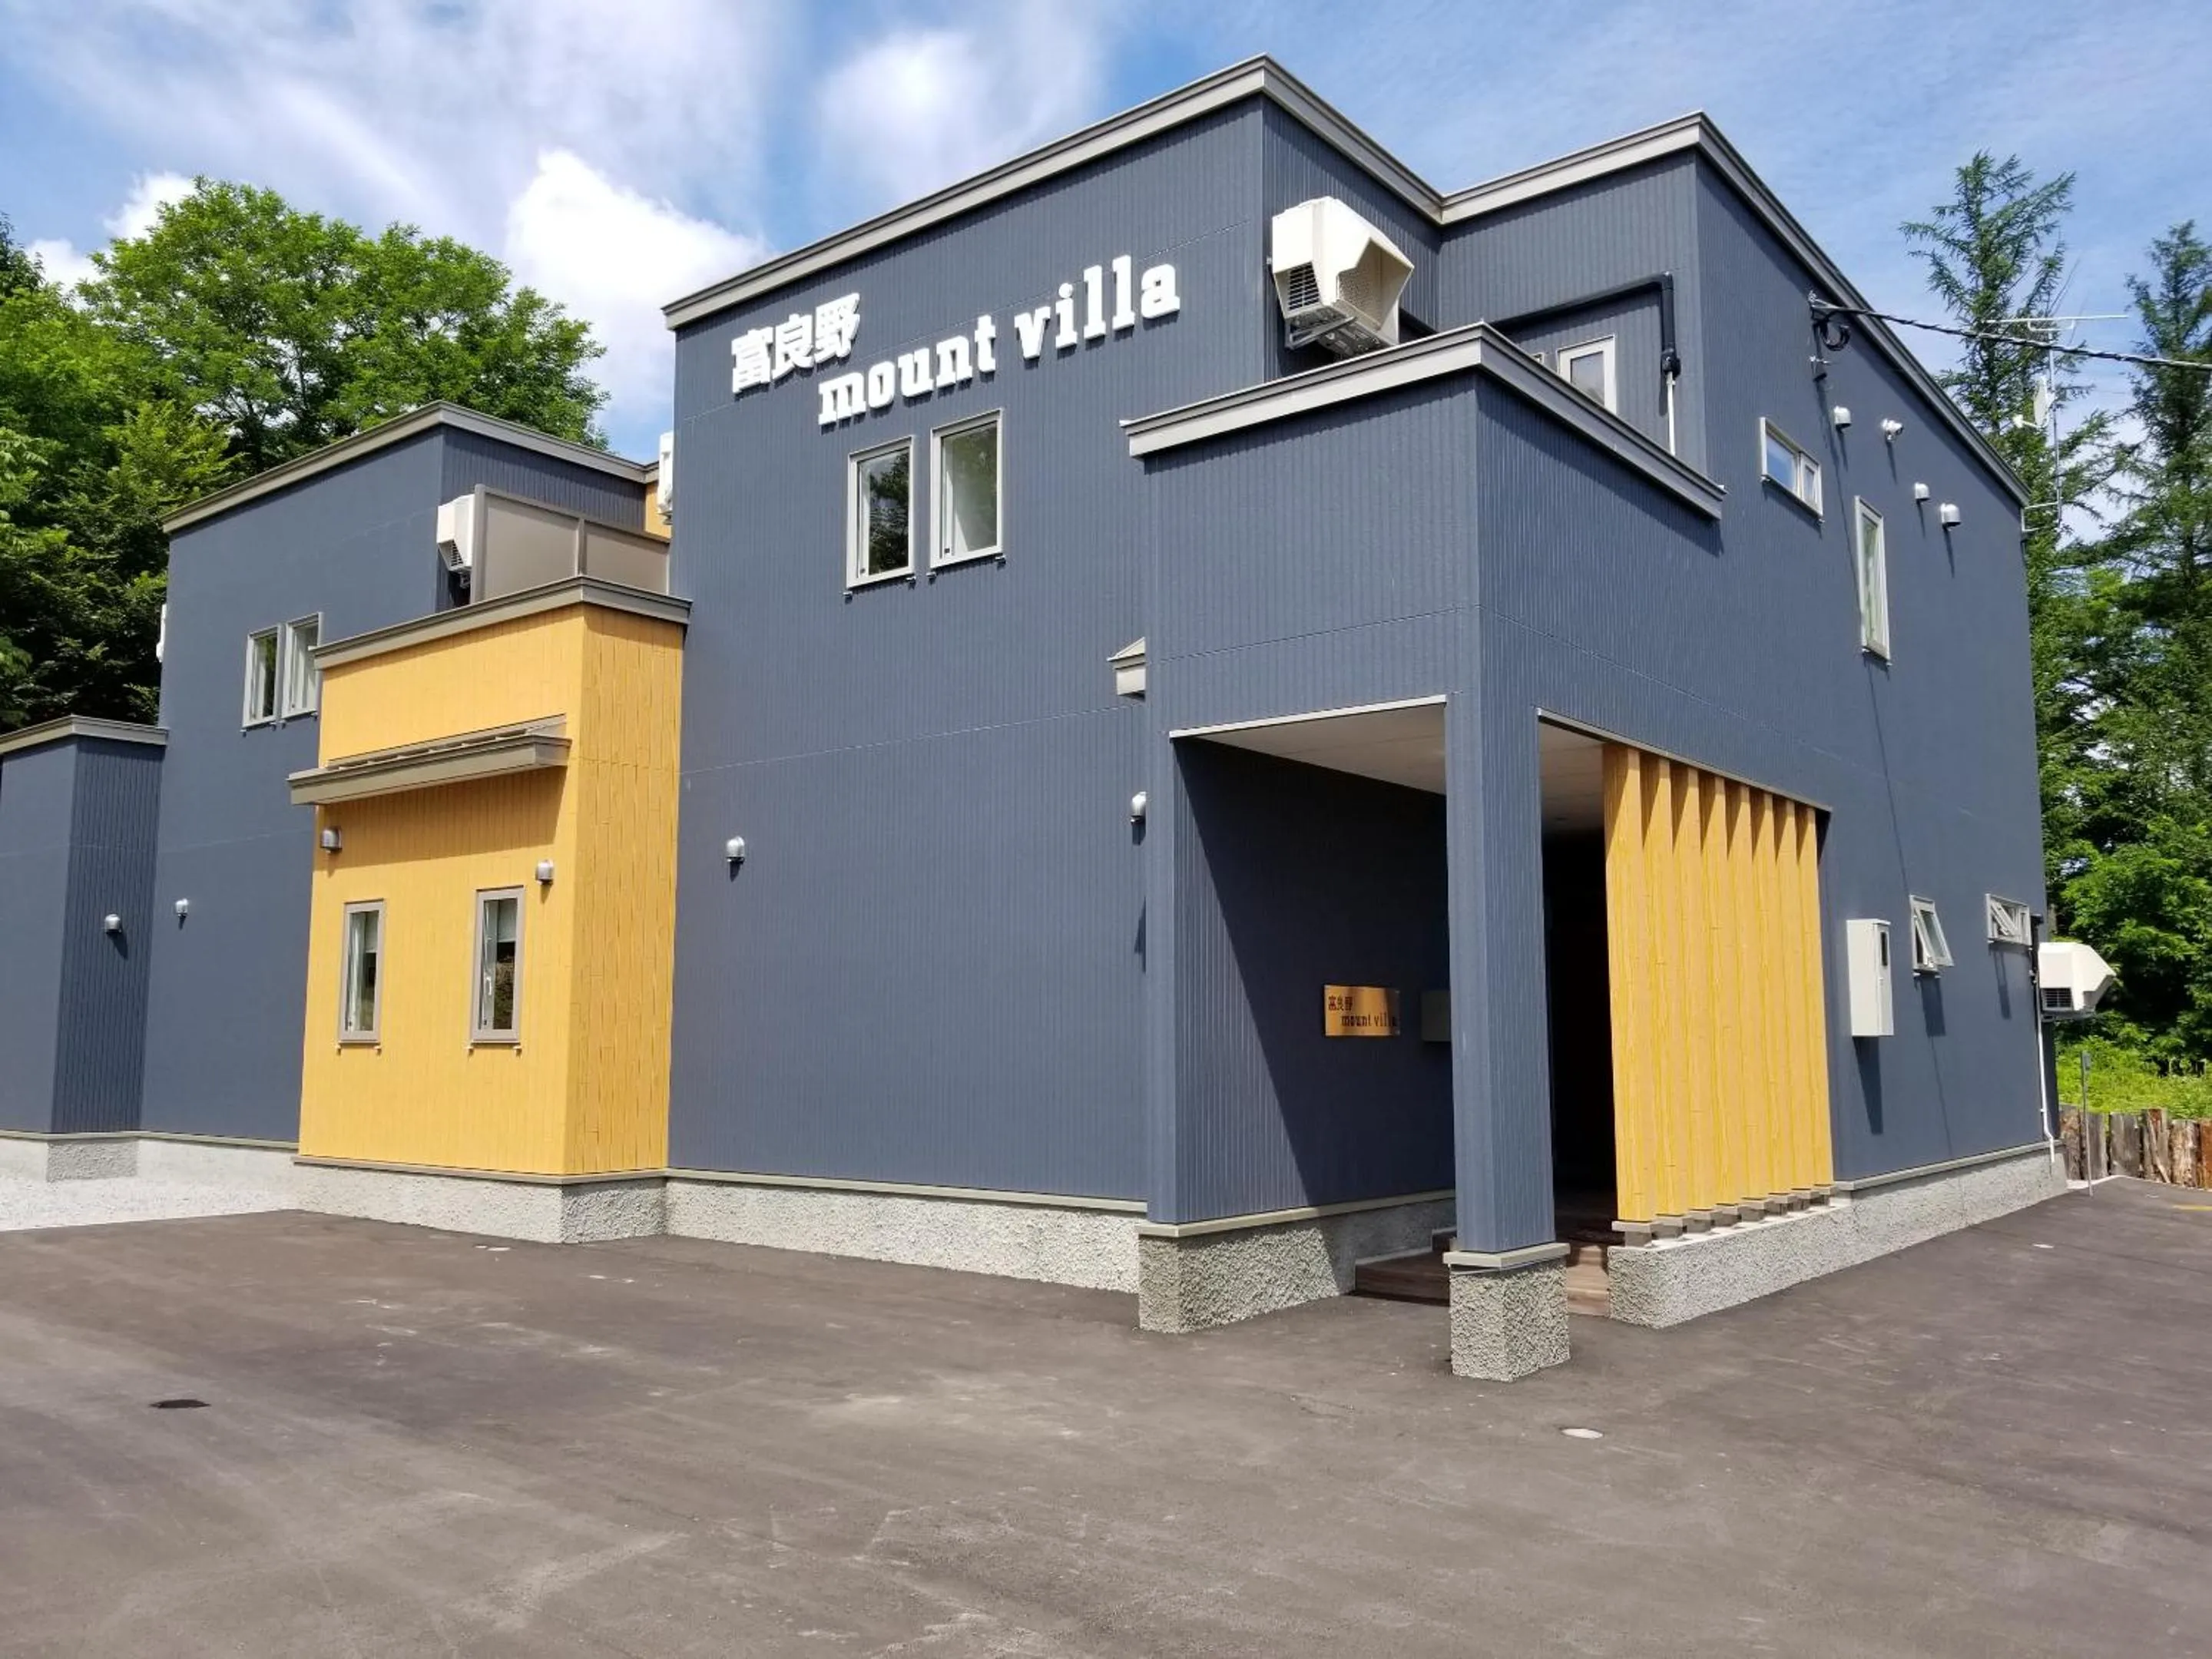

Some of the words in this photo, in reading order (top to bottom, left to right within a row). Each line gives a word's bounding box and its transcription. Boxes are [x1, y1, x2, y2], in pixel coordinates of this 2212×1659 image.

[731, 292, 861, 393] 富良野
[817, 315, 997, 426] mount
[1014, 254, 1181, 360] villa
[1341, 1014, 1372, 1026] mount
